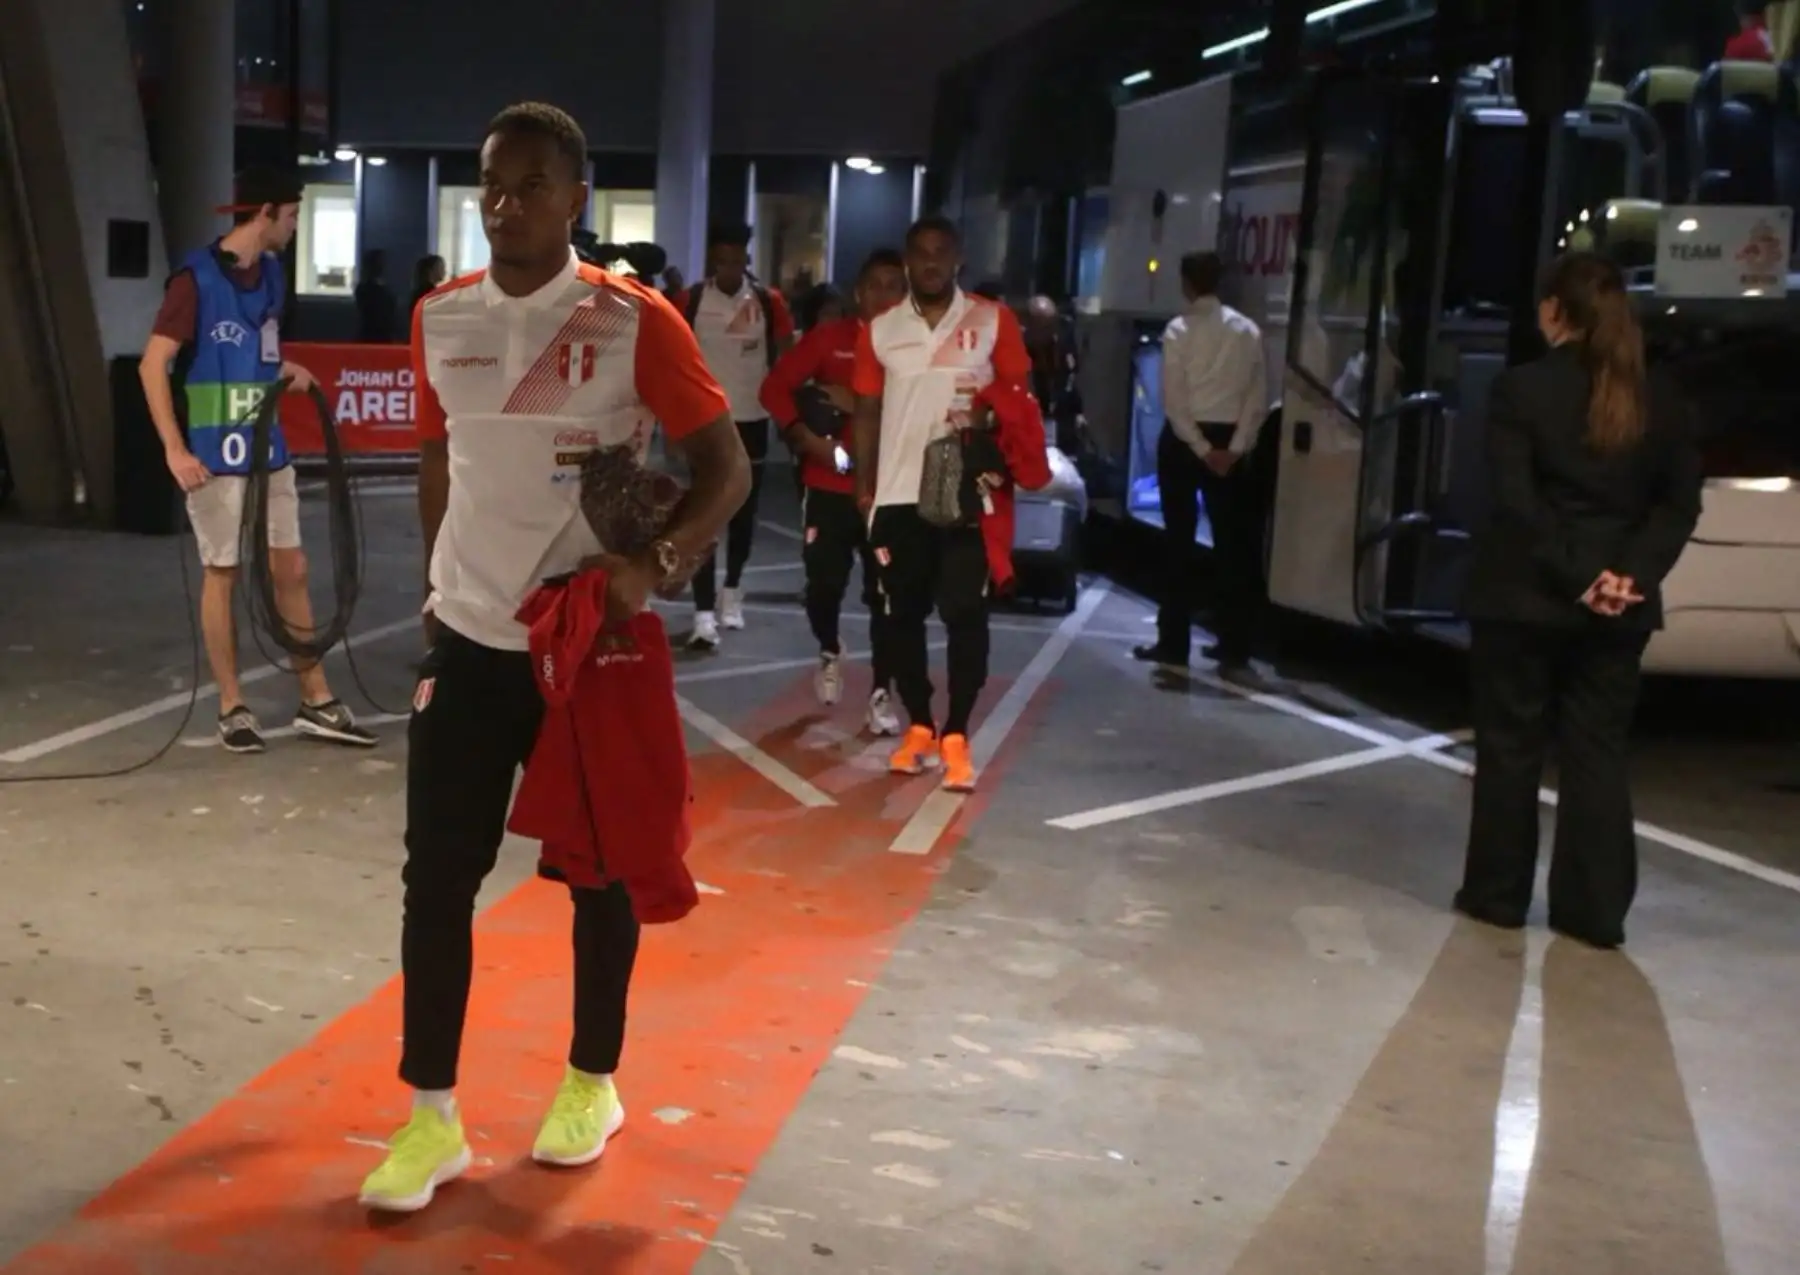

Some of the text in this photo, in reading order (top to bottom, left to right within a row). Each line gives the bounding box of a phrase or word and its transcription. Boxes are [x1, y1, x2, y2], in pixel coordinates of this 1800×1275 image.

[1669, 243, 1722, 261] TEAM
[210, 321, 248, 347] UEFA
[441, 356, 498, 369] marathon
[334, 369, 393, 386] JOHAN
